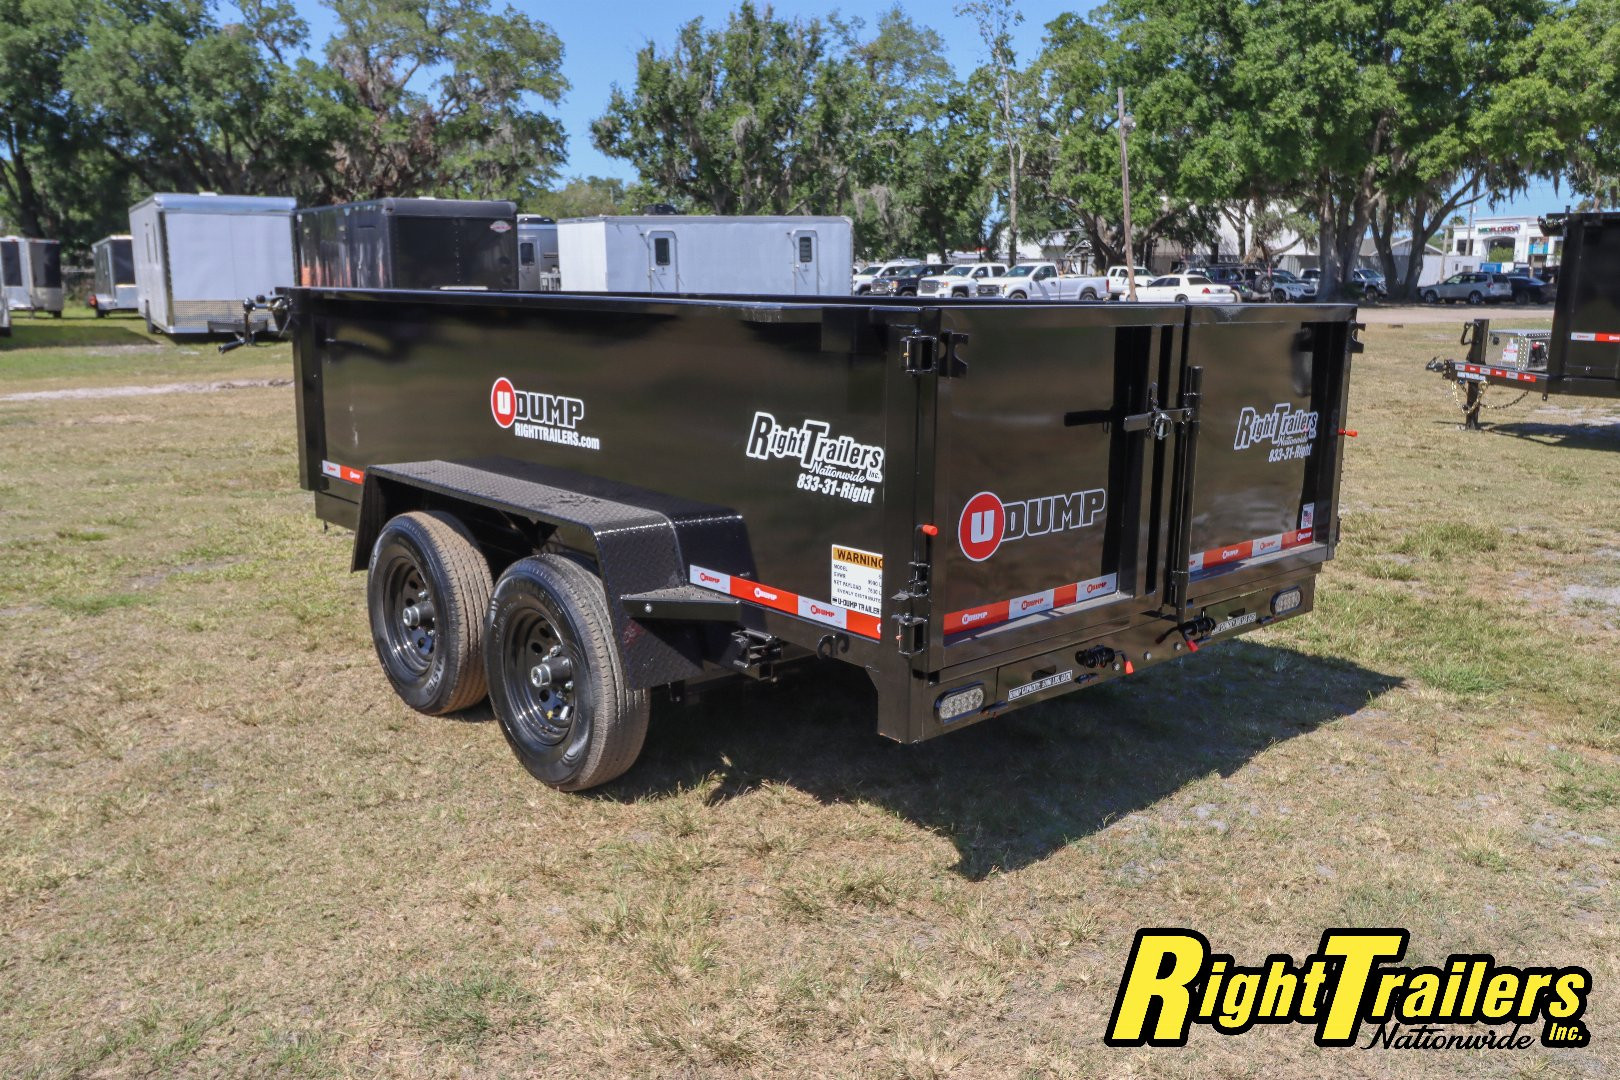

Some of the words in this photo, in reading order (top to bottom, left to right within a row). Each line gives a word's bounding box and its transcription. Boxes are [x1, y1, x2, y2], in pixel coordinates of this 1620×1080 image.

[514, 422, 600, 450] RIGHTTRAILERS.com
[809, 461, 866, 483] Nationwide
[797, 473, 875, 504] 833-31-Right
